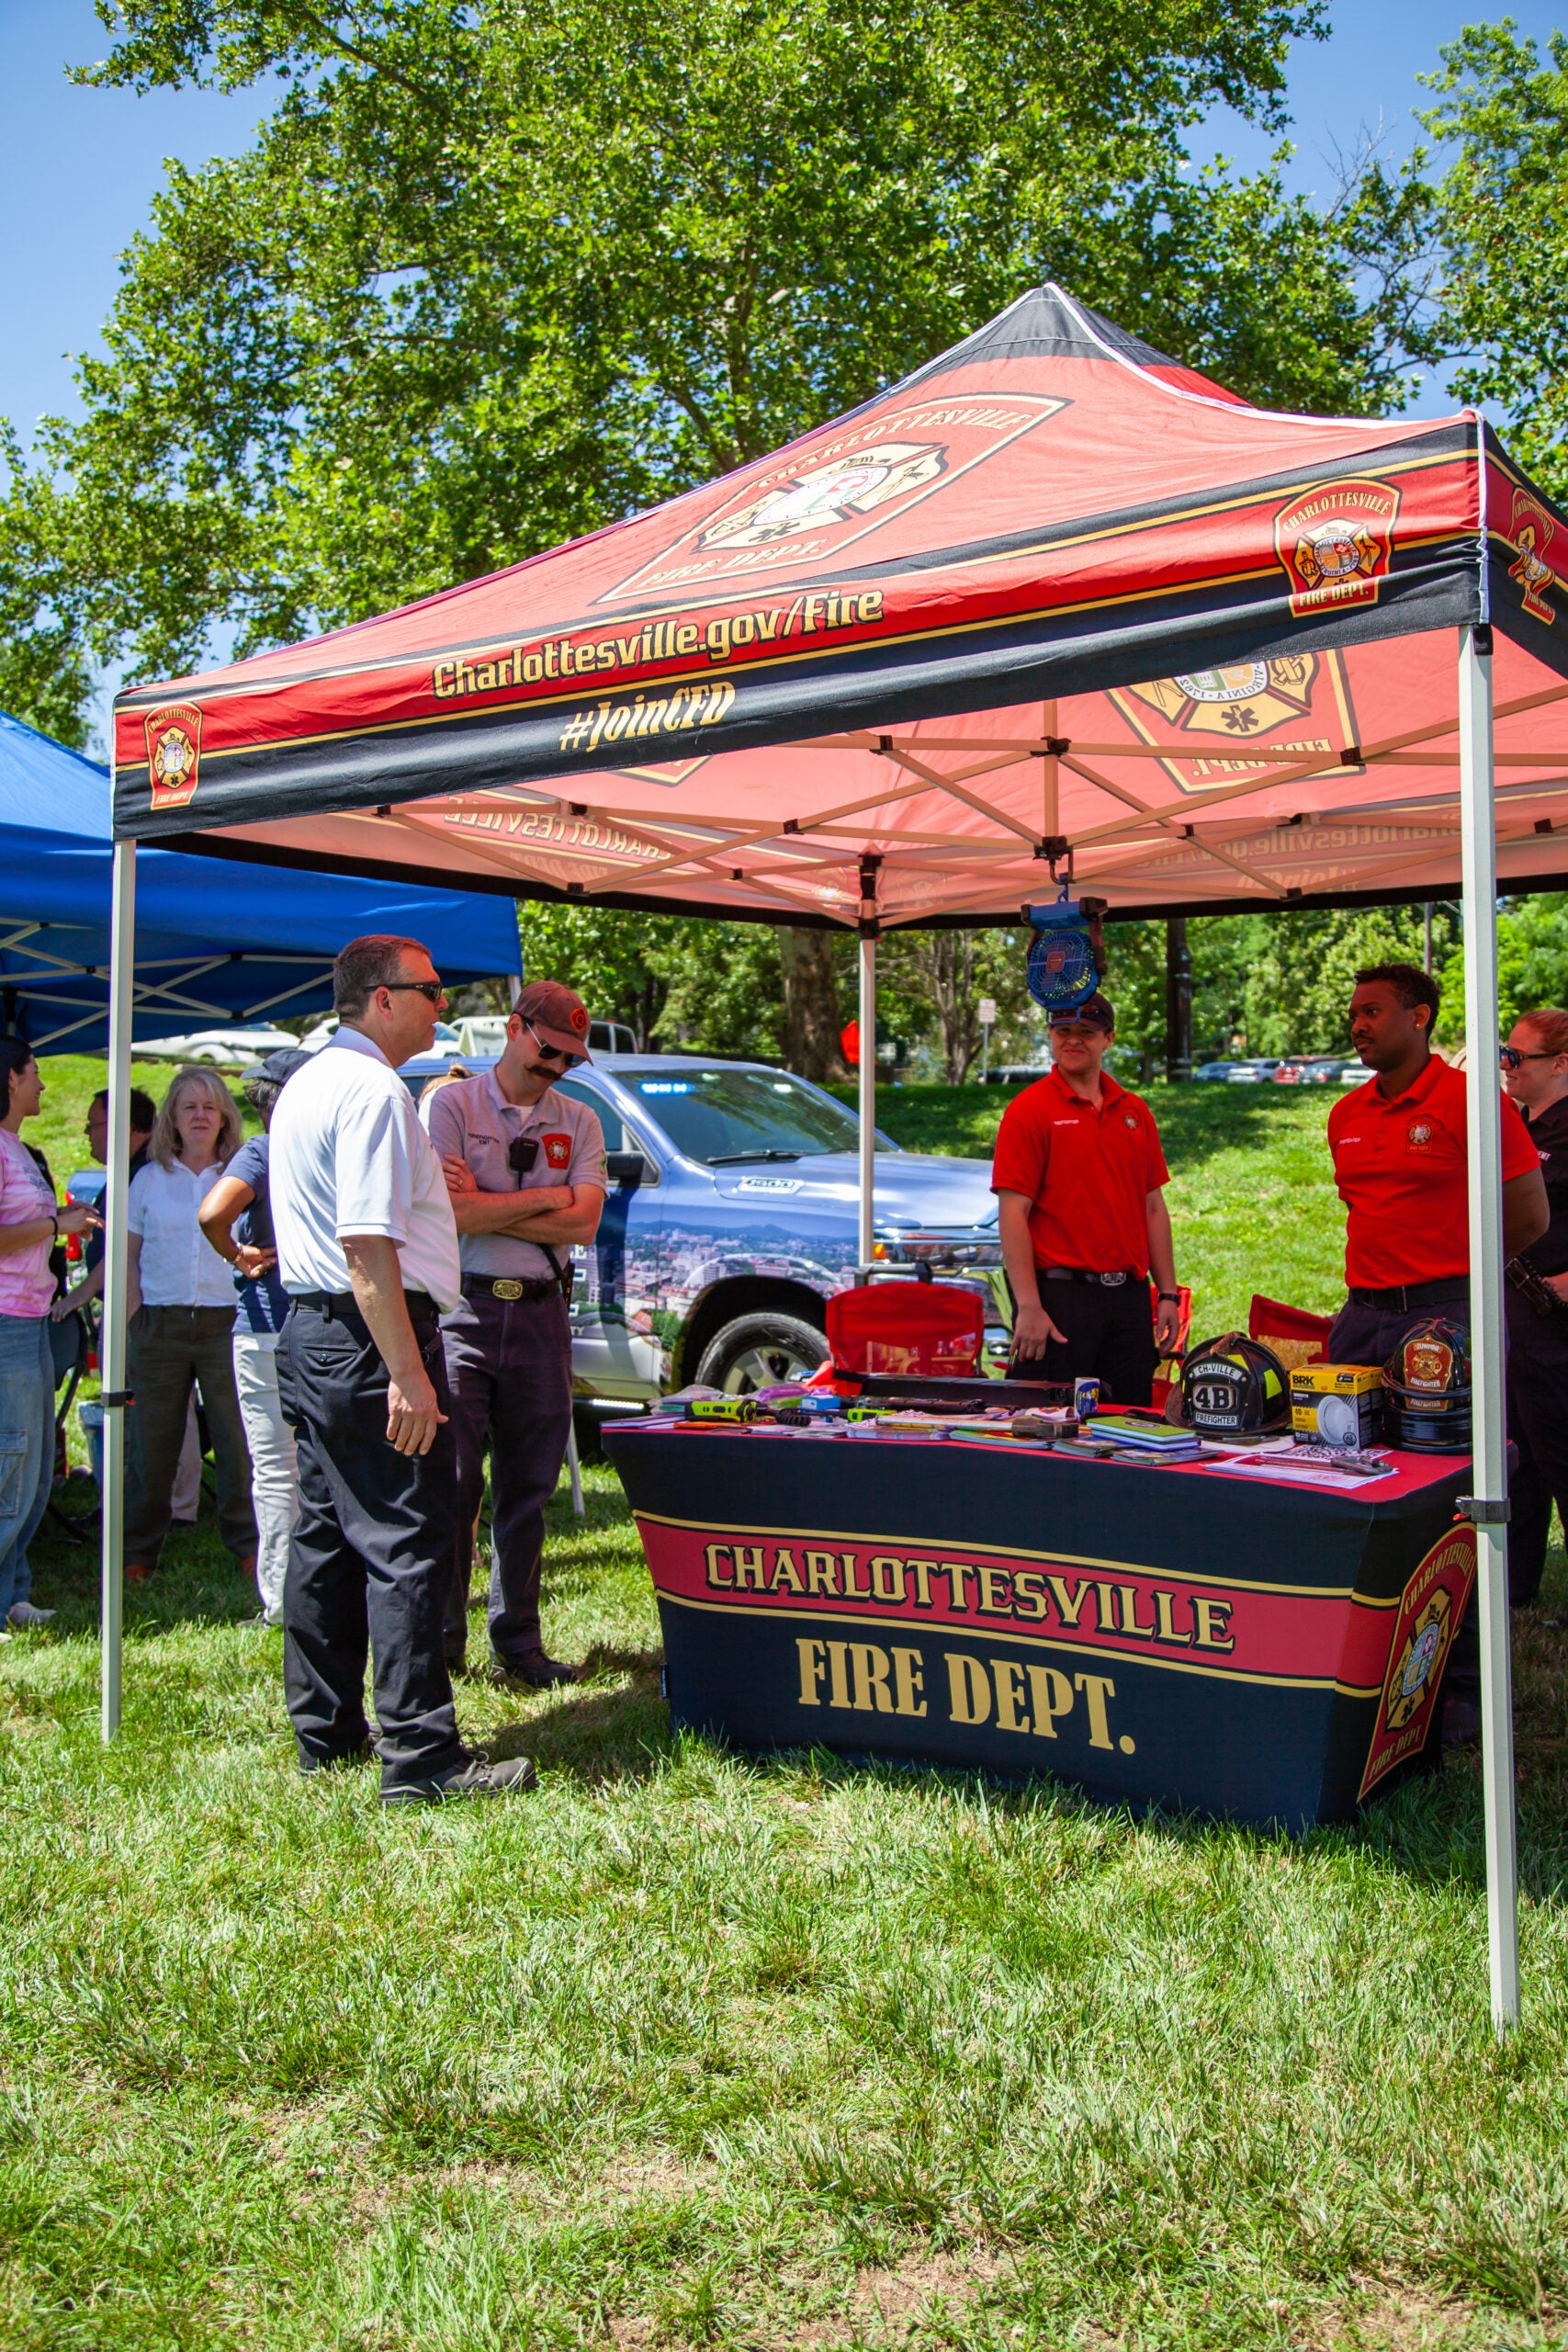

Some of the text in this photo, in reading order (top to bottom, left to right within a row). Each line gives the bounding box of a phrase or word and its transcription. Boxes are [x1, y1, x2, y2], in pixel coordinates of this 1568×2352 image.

[757, 408, 1033, 488] CHARLOTTESVILLE
[1283, 492, 1392, 531] CHARLOTTESVILLE
[637, 537, 829, 588] FIRE DEPT.
[1299, 581, 1370, 607] FIRE DEPT.
[433, 590, 885, 700] Charlottesville.gov/Fire
[148, 708, 199, 733] CHARLOTTESVILLE
[558, 682, 736, 752] #JoinCFD
[156, 793, 172, 804] FIRE
[1416, 1342, 1440, 1352] JUNIOR
[1198, 1363, 1235, 1377] CH-VILLE
[1292, 1374, 1315, 1385] BRK
[1410, 1376, 1441, 1388] FIREFIGHTER
[1195, 1387, 1230, 1408] 4B
[1196, 1412, 1235, 1424] FIREFIGHTER
[704, 1543, 1236, 1654] CHARLOTTESVILLE
[795, 1636, 1138, 1756] FIRE DEPT.
[1368, 1742, 1395, 1781] FIRE
